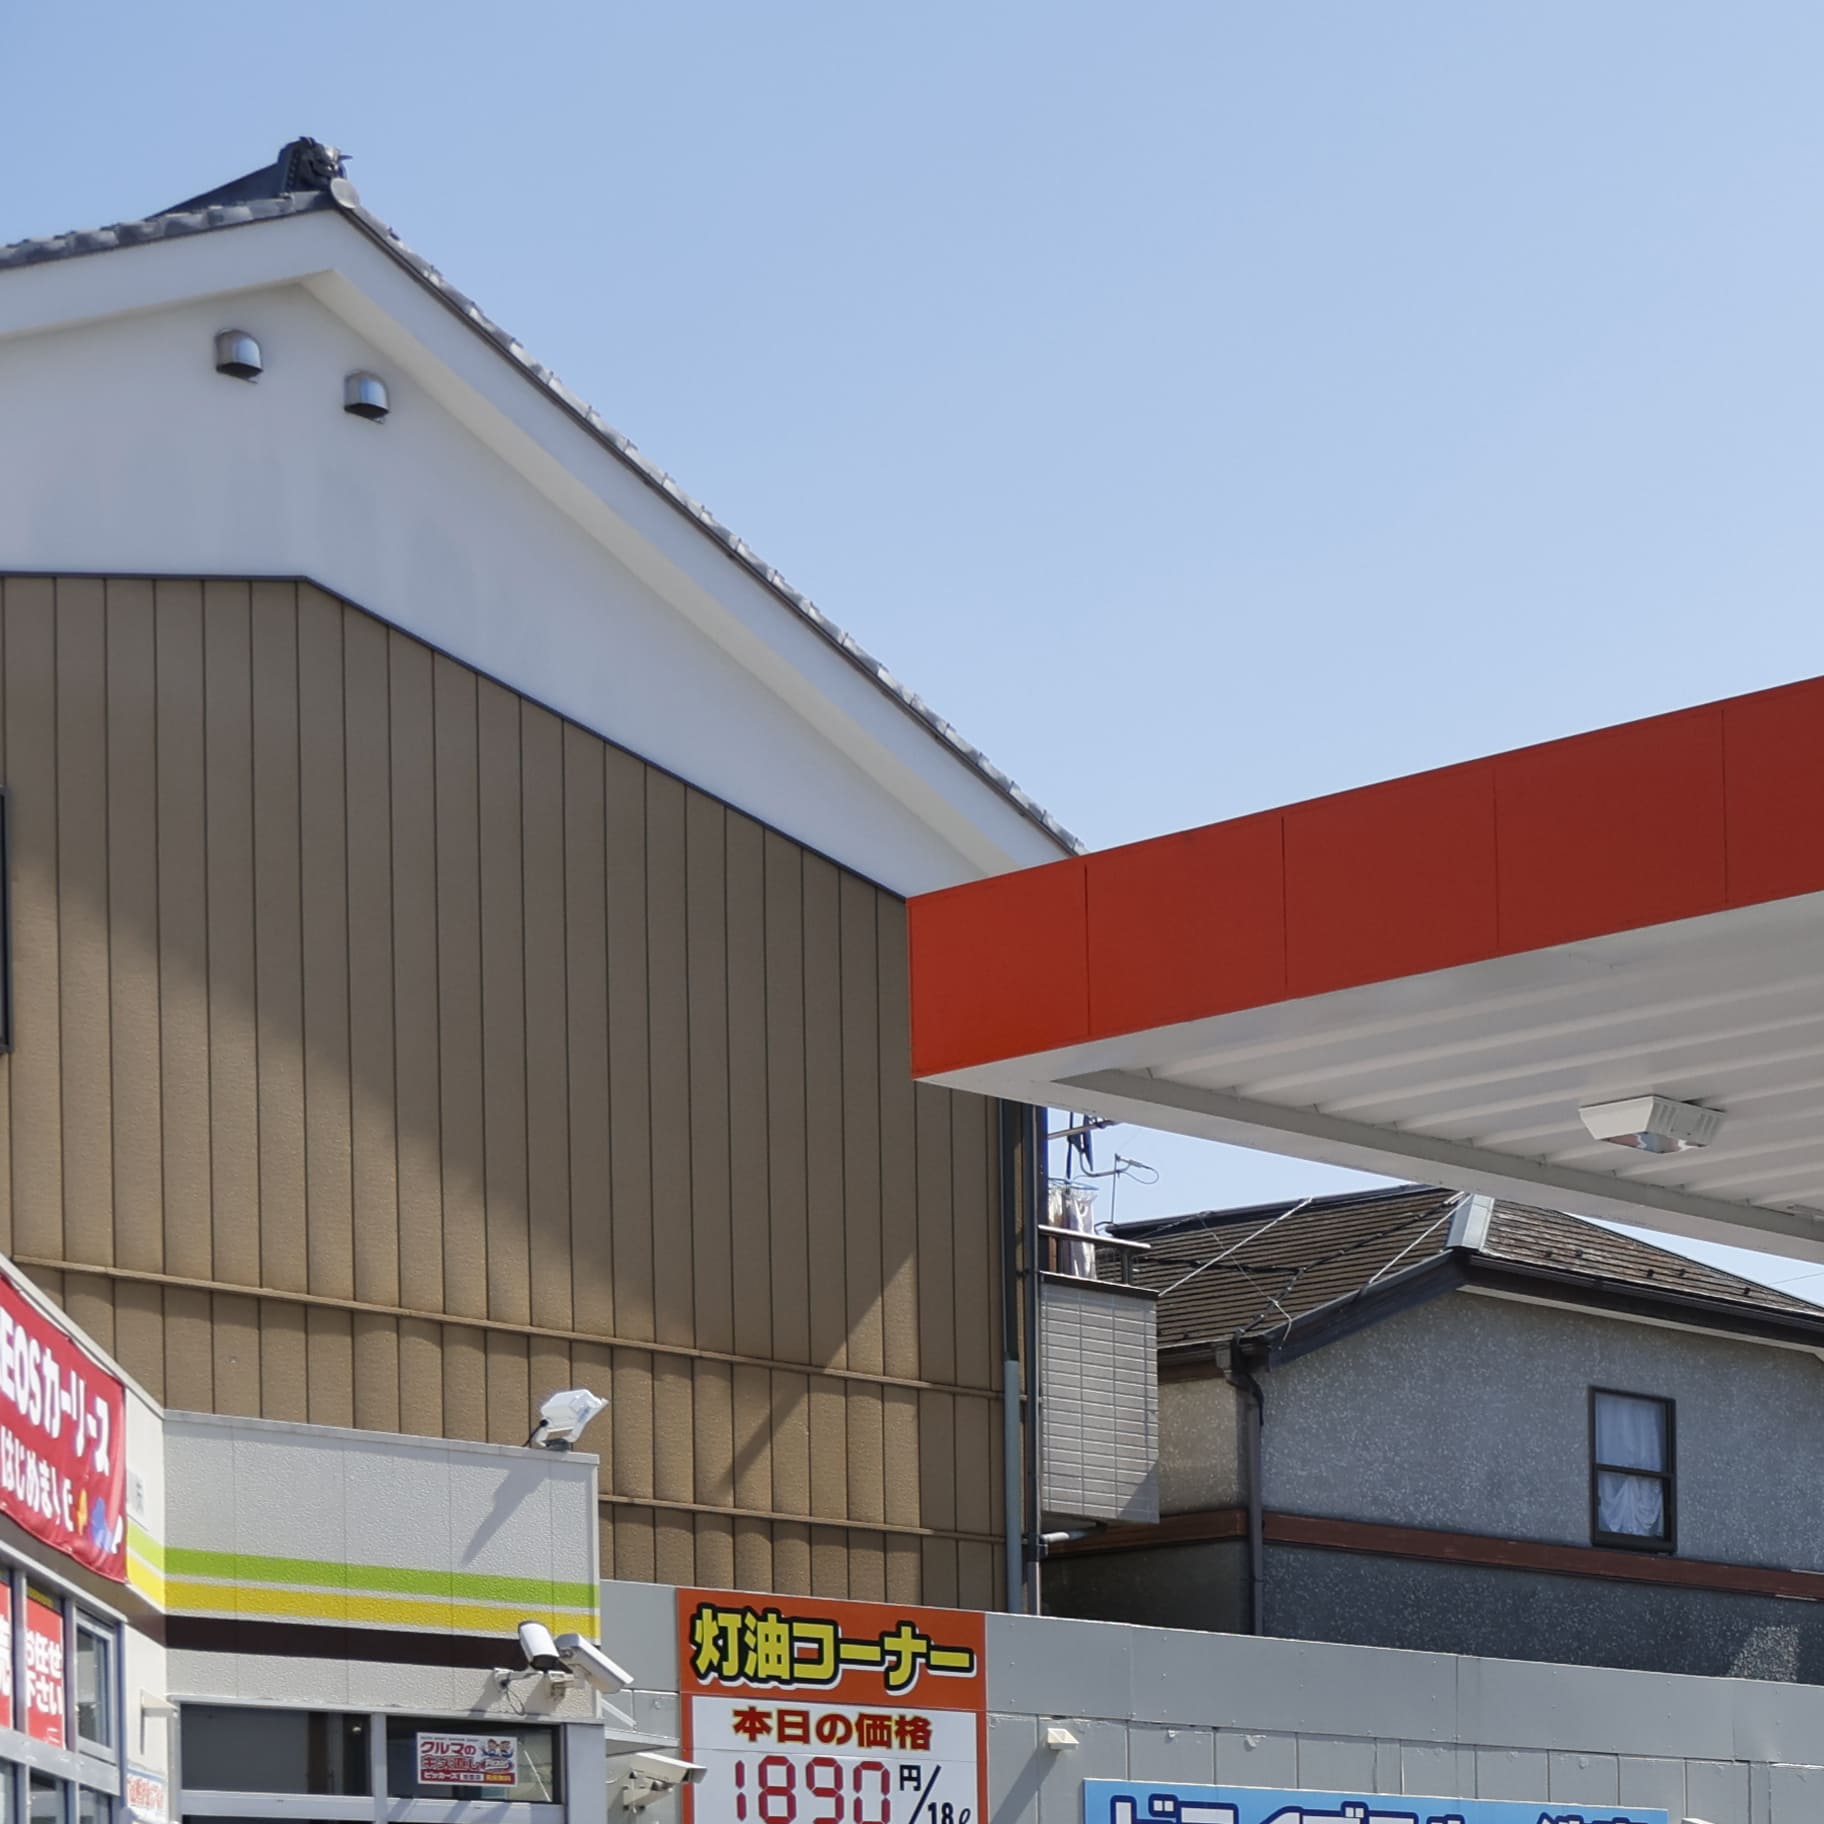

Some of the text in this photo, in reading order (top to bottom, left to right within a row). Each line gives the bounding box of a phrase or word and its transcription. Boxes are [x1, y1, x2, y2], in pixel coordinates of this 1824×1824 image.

[692, 1603, 975, 1692] 灯油コーナー
[421, 1741, 476, 1755] クルマの
[732, 1706, 933, 1751] 本日の価格
